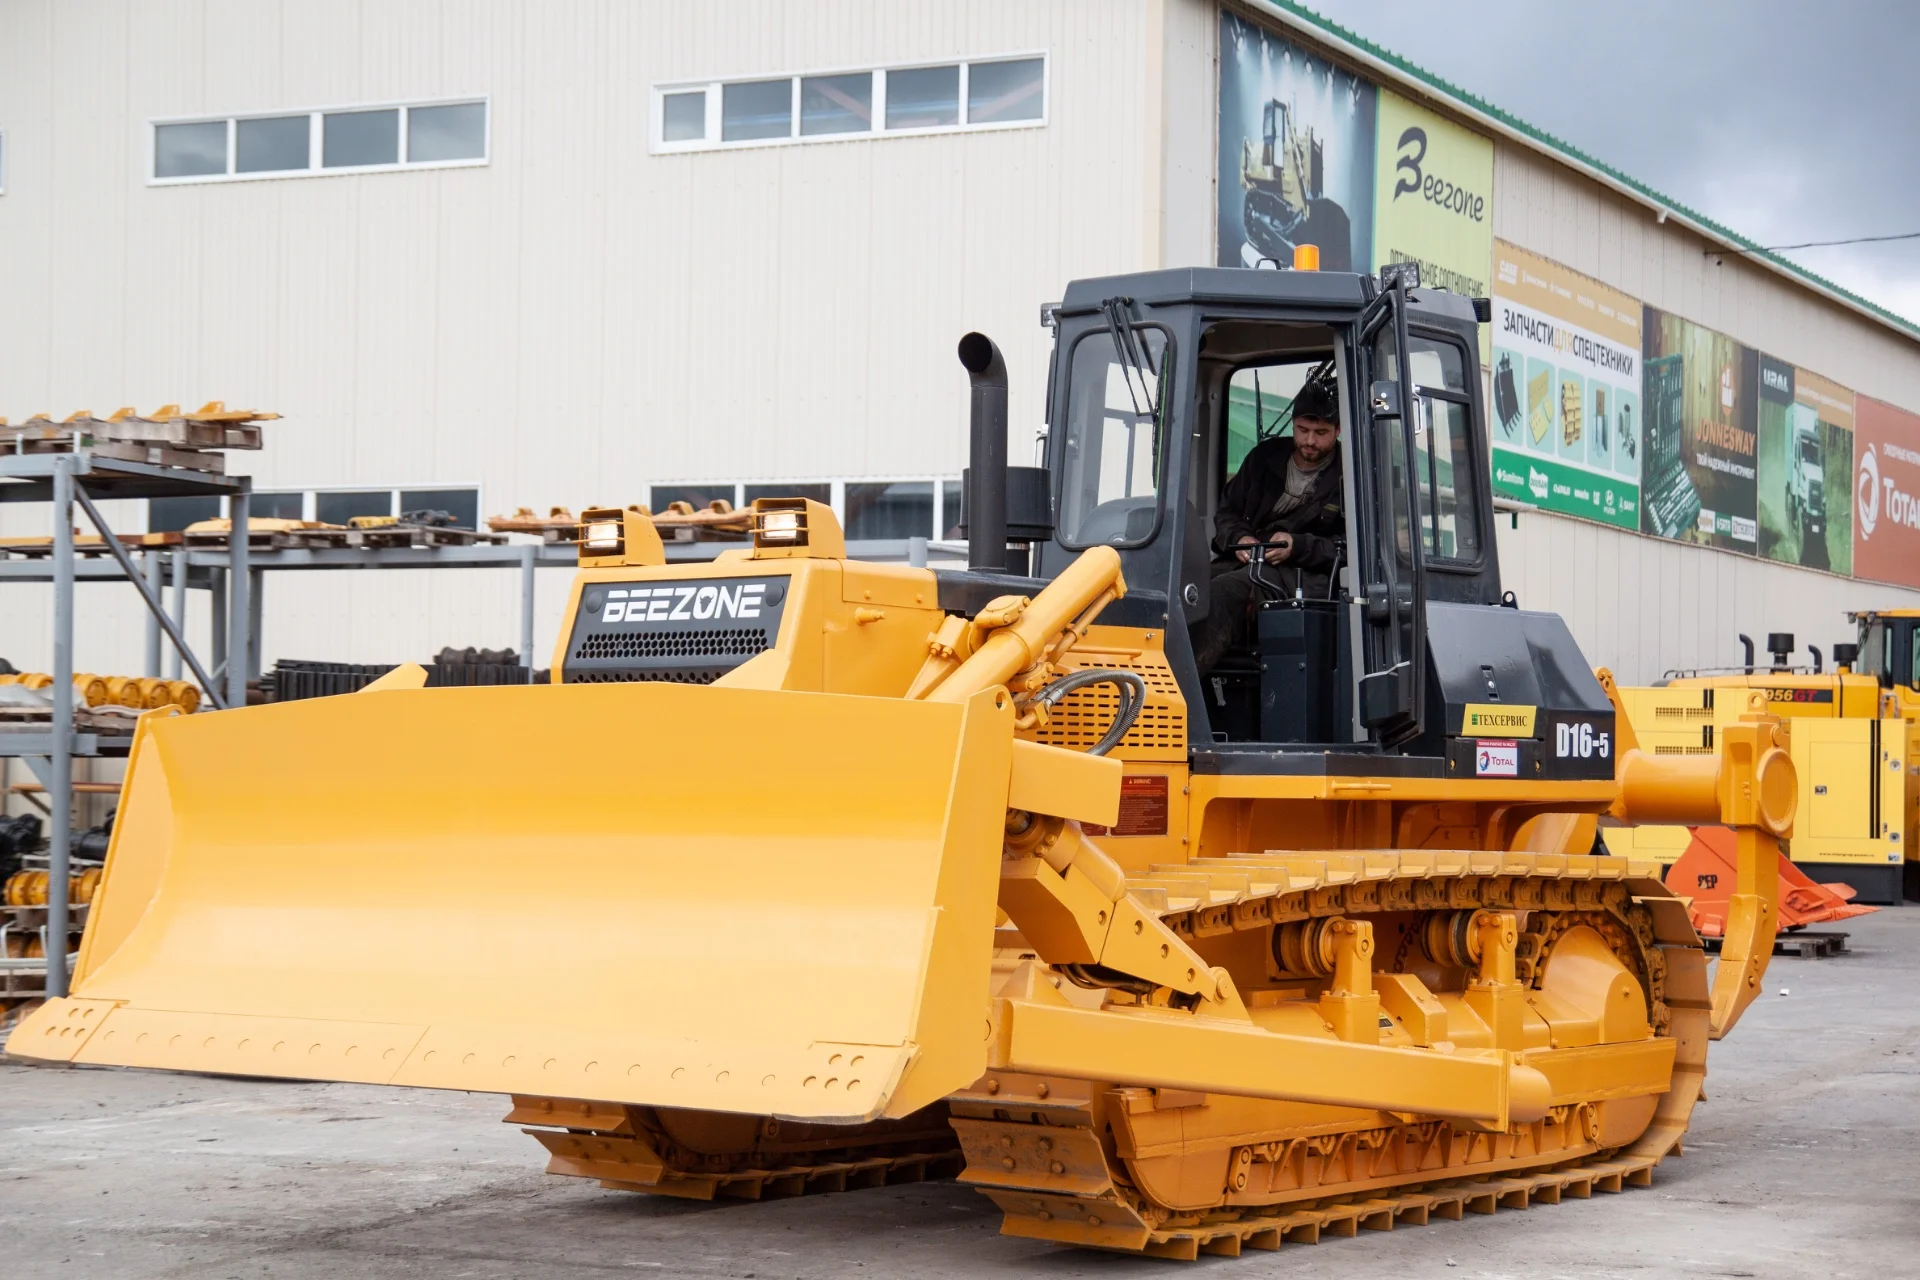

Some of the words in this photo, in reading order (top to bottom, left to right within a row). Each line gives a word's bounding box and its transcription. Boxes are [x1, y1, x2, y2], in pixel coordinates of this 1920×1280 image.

[1503, 308, 1554, 347] ЗАПЧАСТИ
[1554, 327, 1573, 355] ДЛЯ
[1573, 334, 1633, 377] СПЕЦТЕХНИКИ
[1696, 419, 1756, 456] JONNESWAY
[602, 584, 767, 623] BEEZONE
[1478, 714, 1528, 727] ТЕХСЕРВИС
[1556, 722, 1609, 758] D16-5
